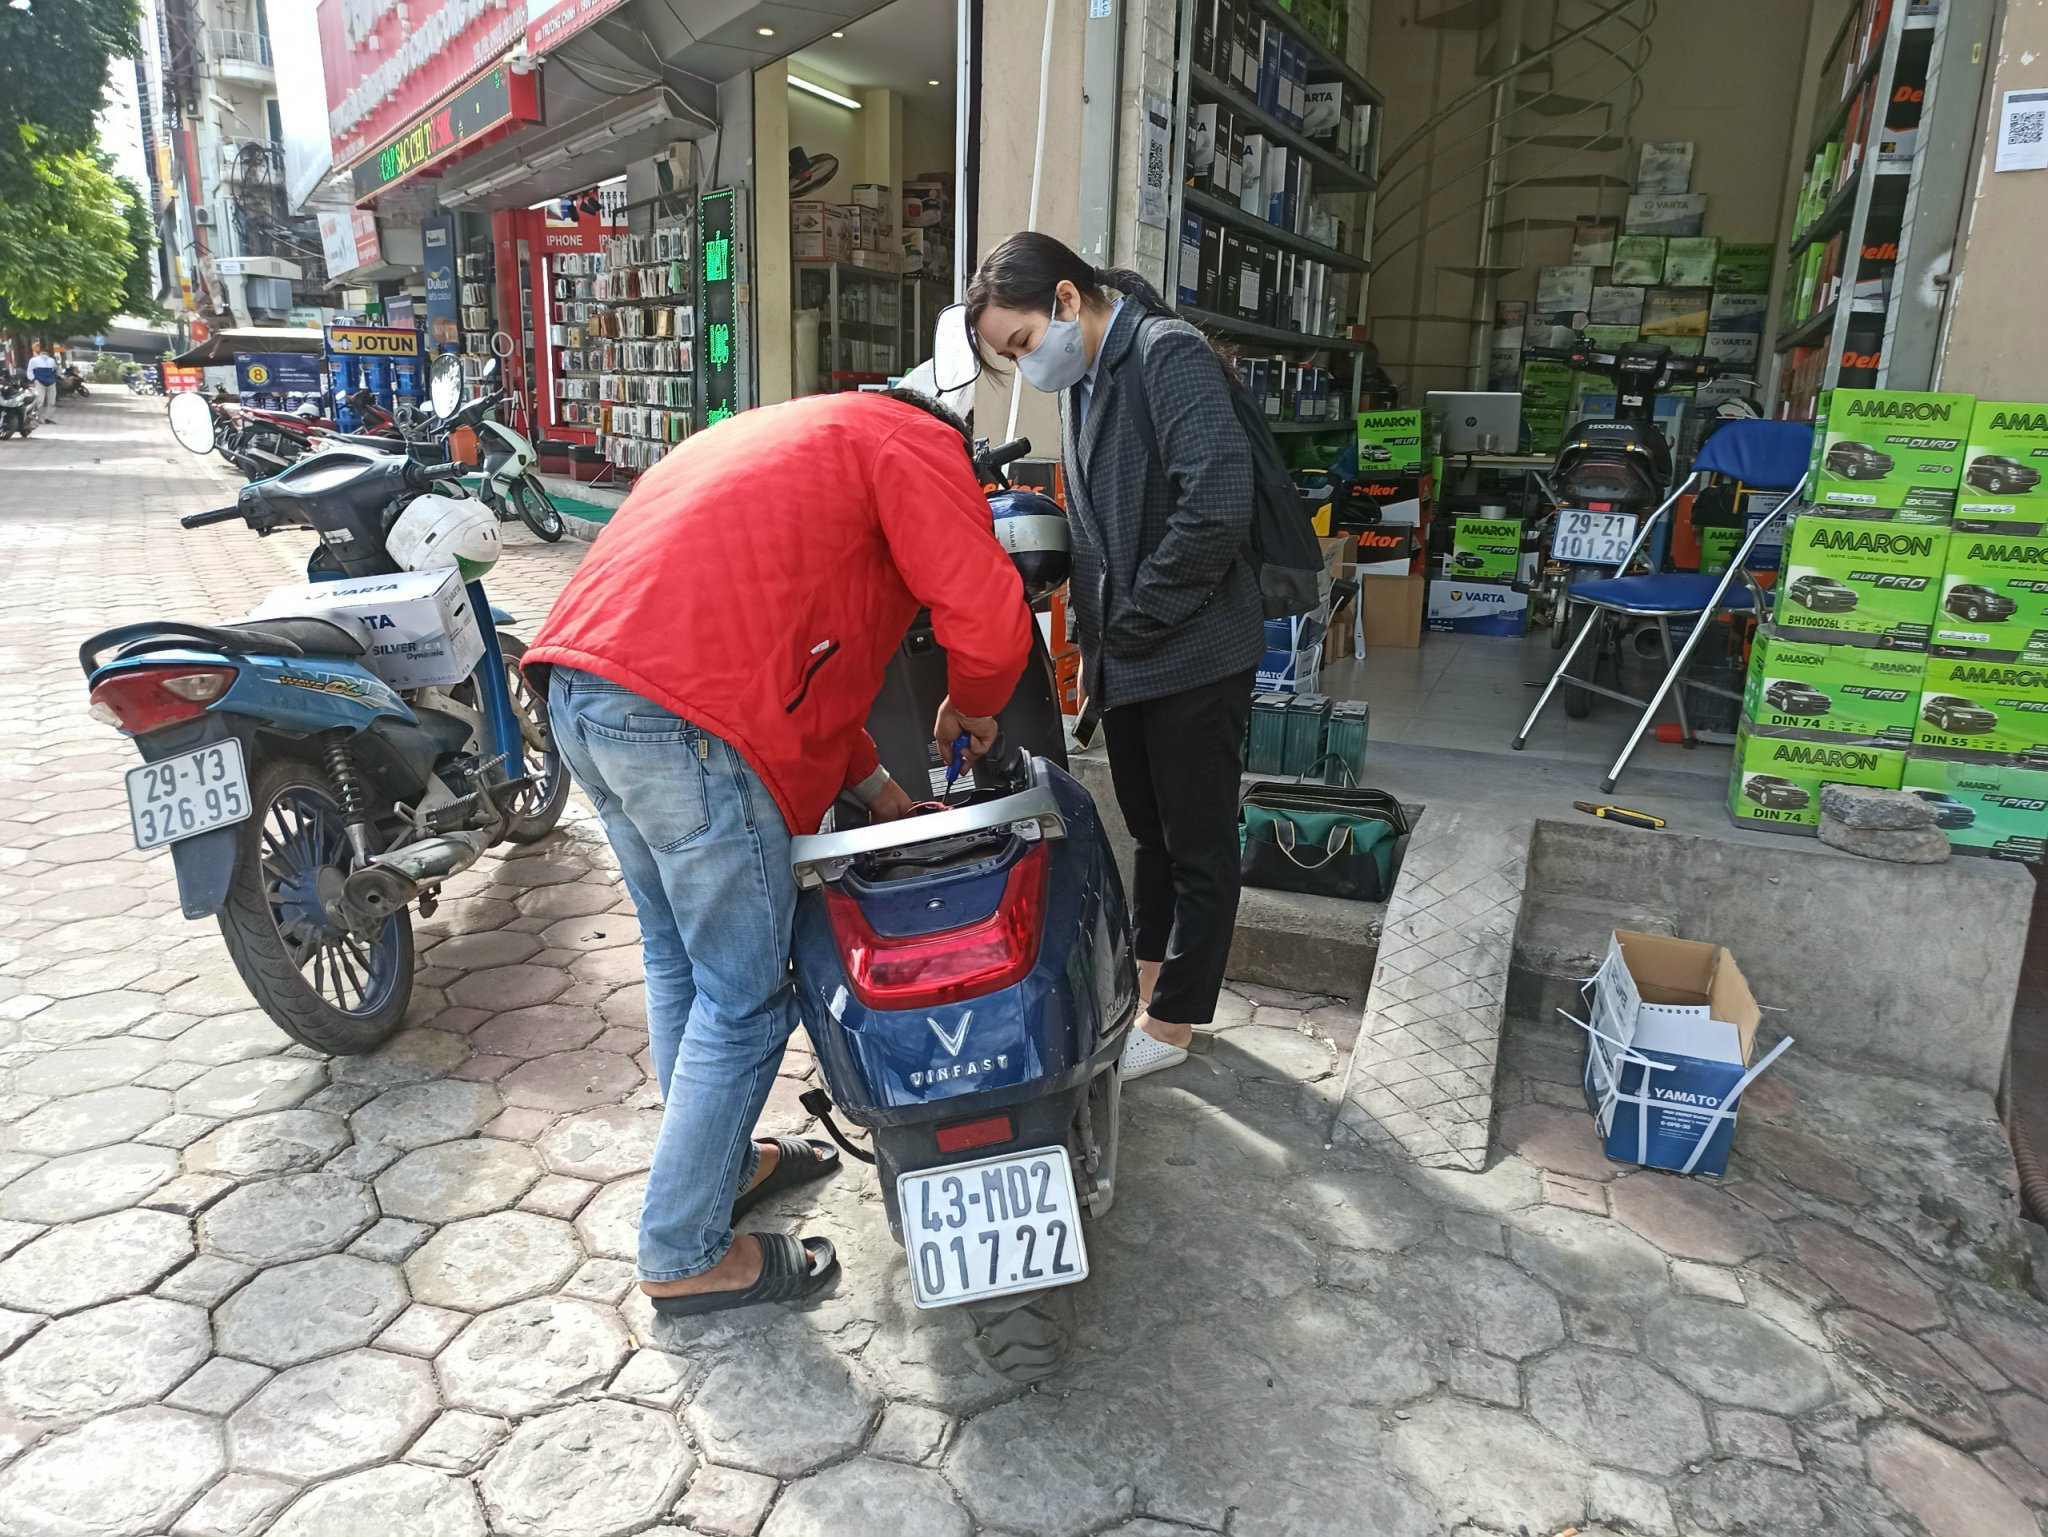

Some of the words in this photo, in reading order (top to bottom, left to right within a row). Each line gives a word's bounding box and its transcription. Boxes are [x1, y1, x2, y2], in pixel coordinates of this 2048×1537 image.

[1305, 92, 1333, 103] ARTA
[1656, 201, 1689, 209] VARTA
[546, 235, 584, 246] IPHONE
[427, 278, 449, 289] Dulux
[355, 336, 414, 352] JOTUN
[1722, 338, 1753, 346] VARTA
[253, 368, 263, 381] 8
[1847, 399, 1952, 421] AMARON
[1364, 416, 1416, 429] AMARON
[1588, 423, 1634, 431] HONDA
[1462, 524, 1516, 537] AMARON
[1568, 513, 1626, 538] 29-Z1
[1560, 536, 1630, 562] 101.26
[1810, 528, 1933, 557] AMARON
[1860, 573, 1878, 581] LIFE
[1878, 576, 1927, 589] PRO
[332, 584, 399, 597] VARTA
[1465, 591, 1505, 604] VARTA
[1788, 614, 1840, 630] BH100D26L
[372, 642, 416, 656] SILVER
[406, 650, 444, 661] Dynamic
[1775, 653, 1825, 666] AMARON
[1871, 662, 1922, 674] AMARON
[1866, 689, 1907, 700] PRO
[1772, 715, 1799, 727] DIN
[1802, 717, 1821, 729] 74
[1921, 734, 1947, 745] DIN
[1950, 737, 1968, 747] 55
[1774, 744, 1878, 771] AMARON
[144, 748, 226, 803] 29-Y3
[1956, 780, 2001, 792] AMARON
[2002, 798, 2046, 810] PRO
[141, 782, 242, 842] 326.95
[1753, 808, 1780, 821] DIN
[1784, 811, 1802, 823] 74
[910, 1054, 1009, 1088] VINFAST
[1655, 1088, 1717, 1107] YAMATO
[921, 1161, 1058, 1232] 43-MD2
[919, 1219, 1074, 1296] 017.22
